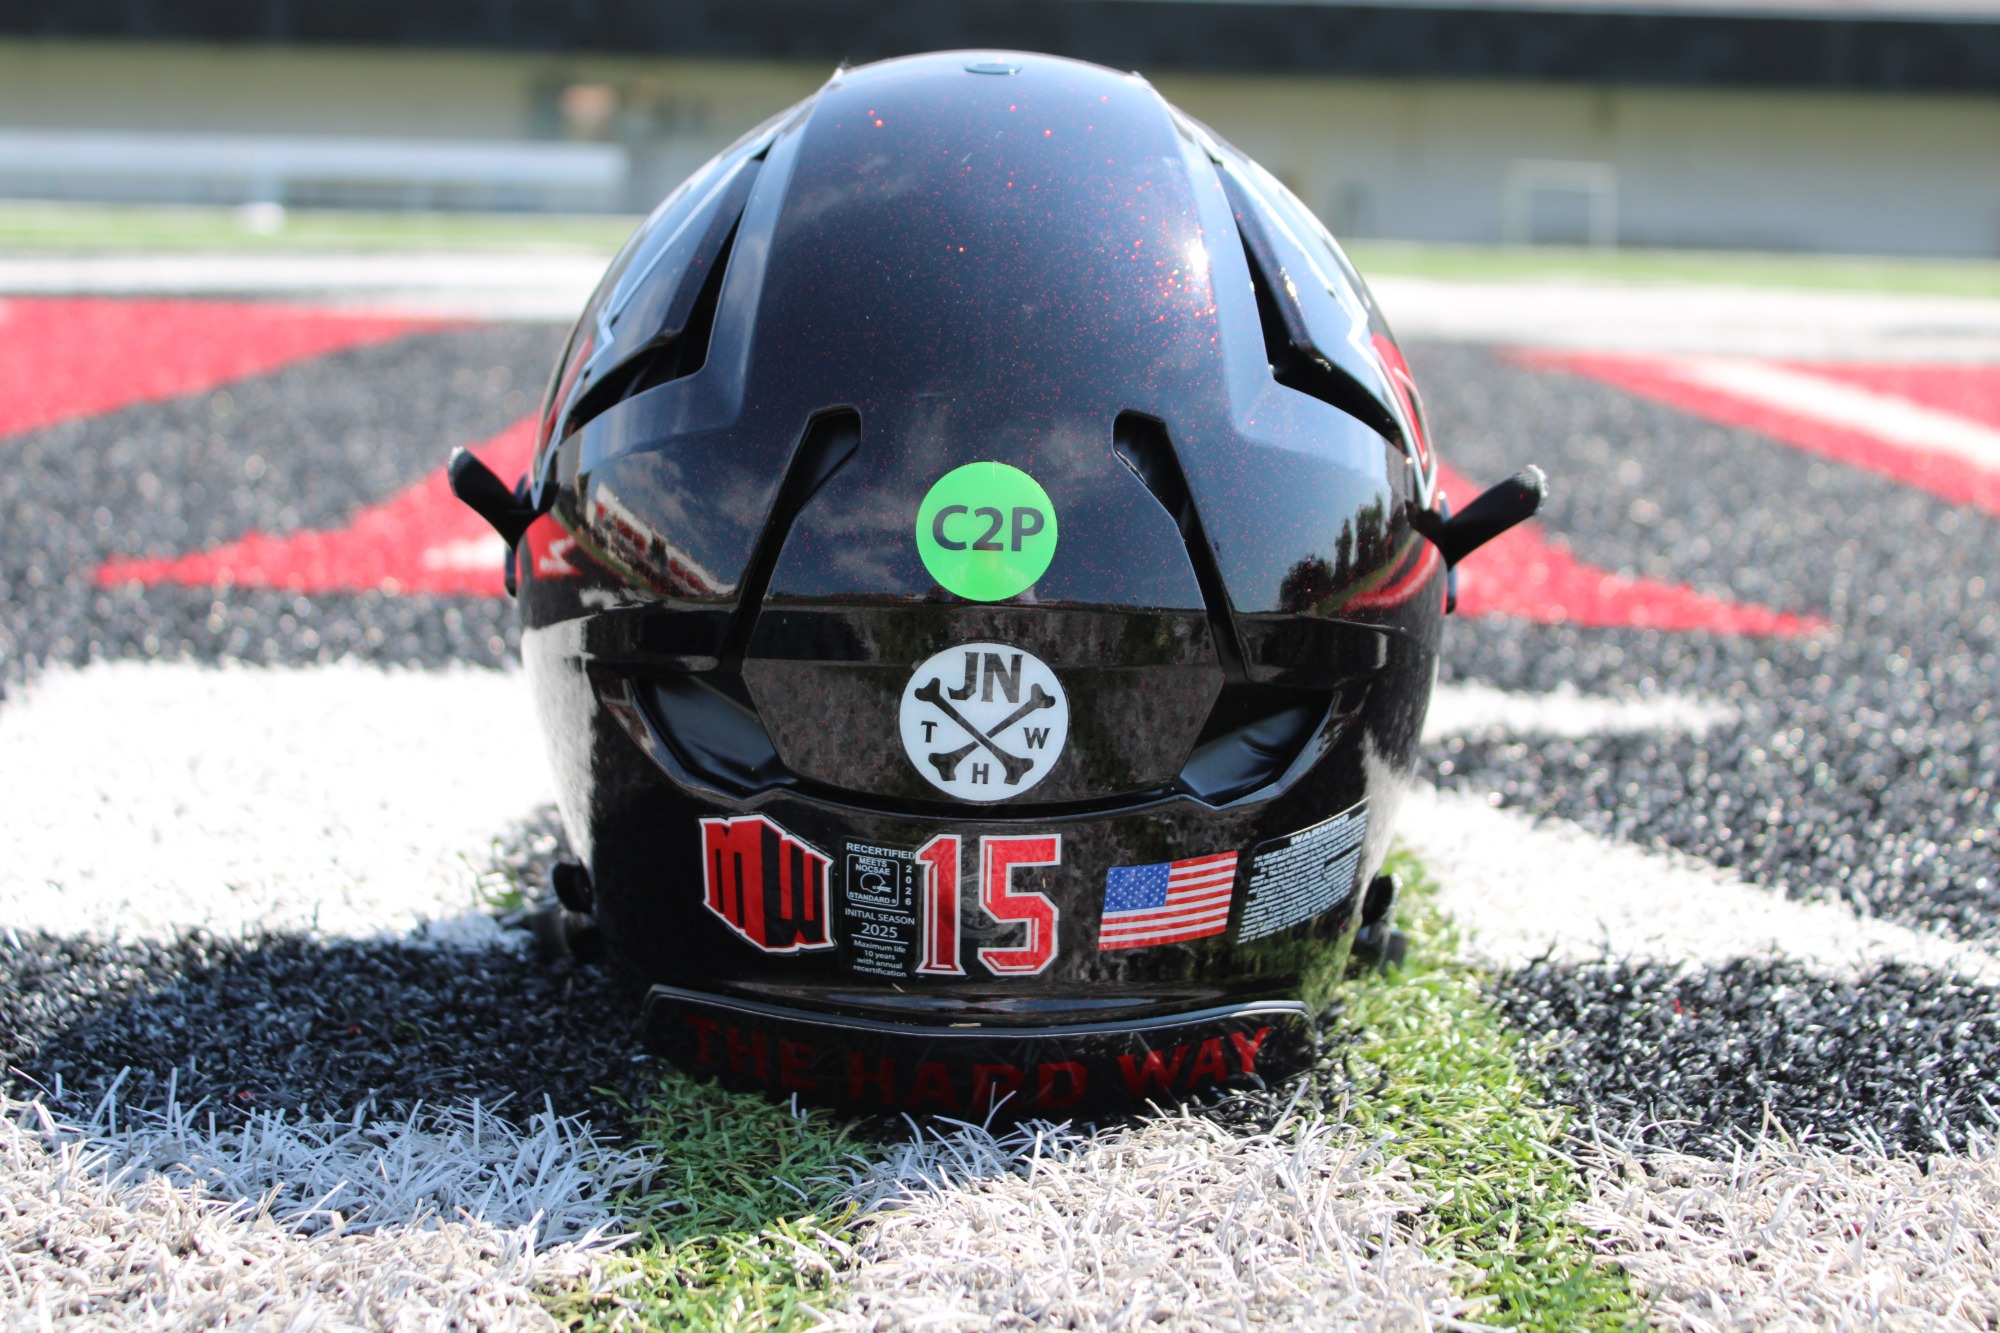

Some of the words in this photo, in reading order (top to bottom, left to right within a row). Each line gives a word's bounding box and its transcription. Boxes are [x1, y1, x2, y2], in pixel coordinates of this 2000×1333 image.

[932, 504, 1045, 552] C2P
[947, 651, 1023, 704] JN
[921, 720, 938, 743] T
[1023, 727, 1051, 749] W
[971, 763, 990, 785] H
[1290, 813, 1350, 845] WARNING
[846, 842, 916, 859] RECERTIFIED
[855, 863, 890, 876] NOCSAE
[858, 856, 888, 868] MEETS
[849, 891, 890, 904] STANDARD
[915, 833, 1061, 976] 15
[845, 907, 876, 921] INITIAL
[877, 913, 915, 926] SEASON
[861, 922, 898, 938] 2025
[853, 939, 892, 952] Maximum
[893, 945, 906, 954] life
[864, 949, 874, 957] 10
[875, 952, 896, 961] years
[853, 964, 907, 978] recertification
[857, 957, 874, 966] with
[875, 960, 903, 969] annual
[685, 1013, 816, 1091] THE
[848, 1052, 1088, 1112] HARD
[1117, 1026, 1271, 1097] WAY
